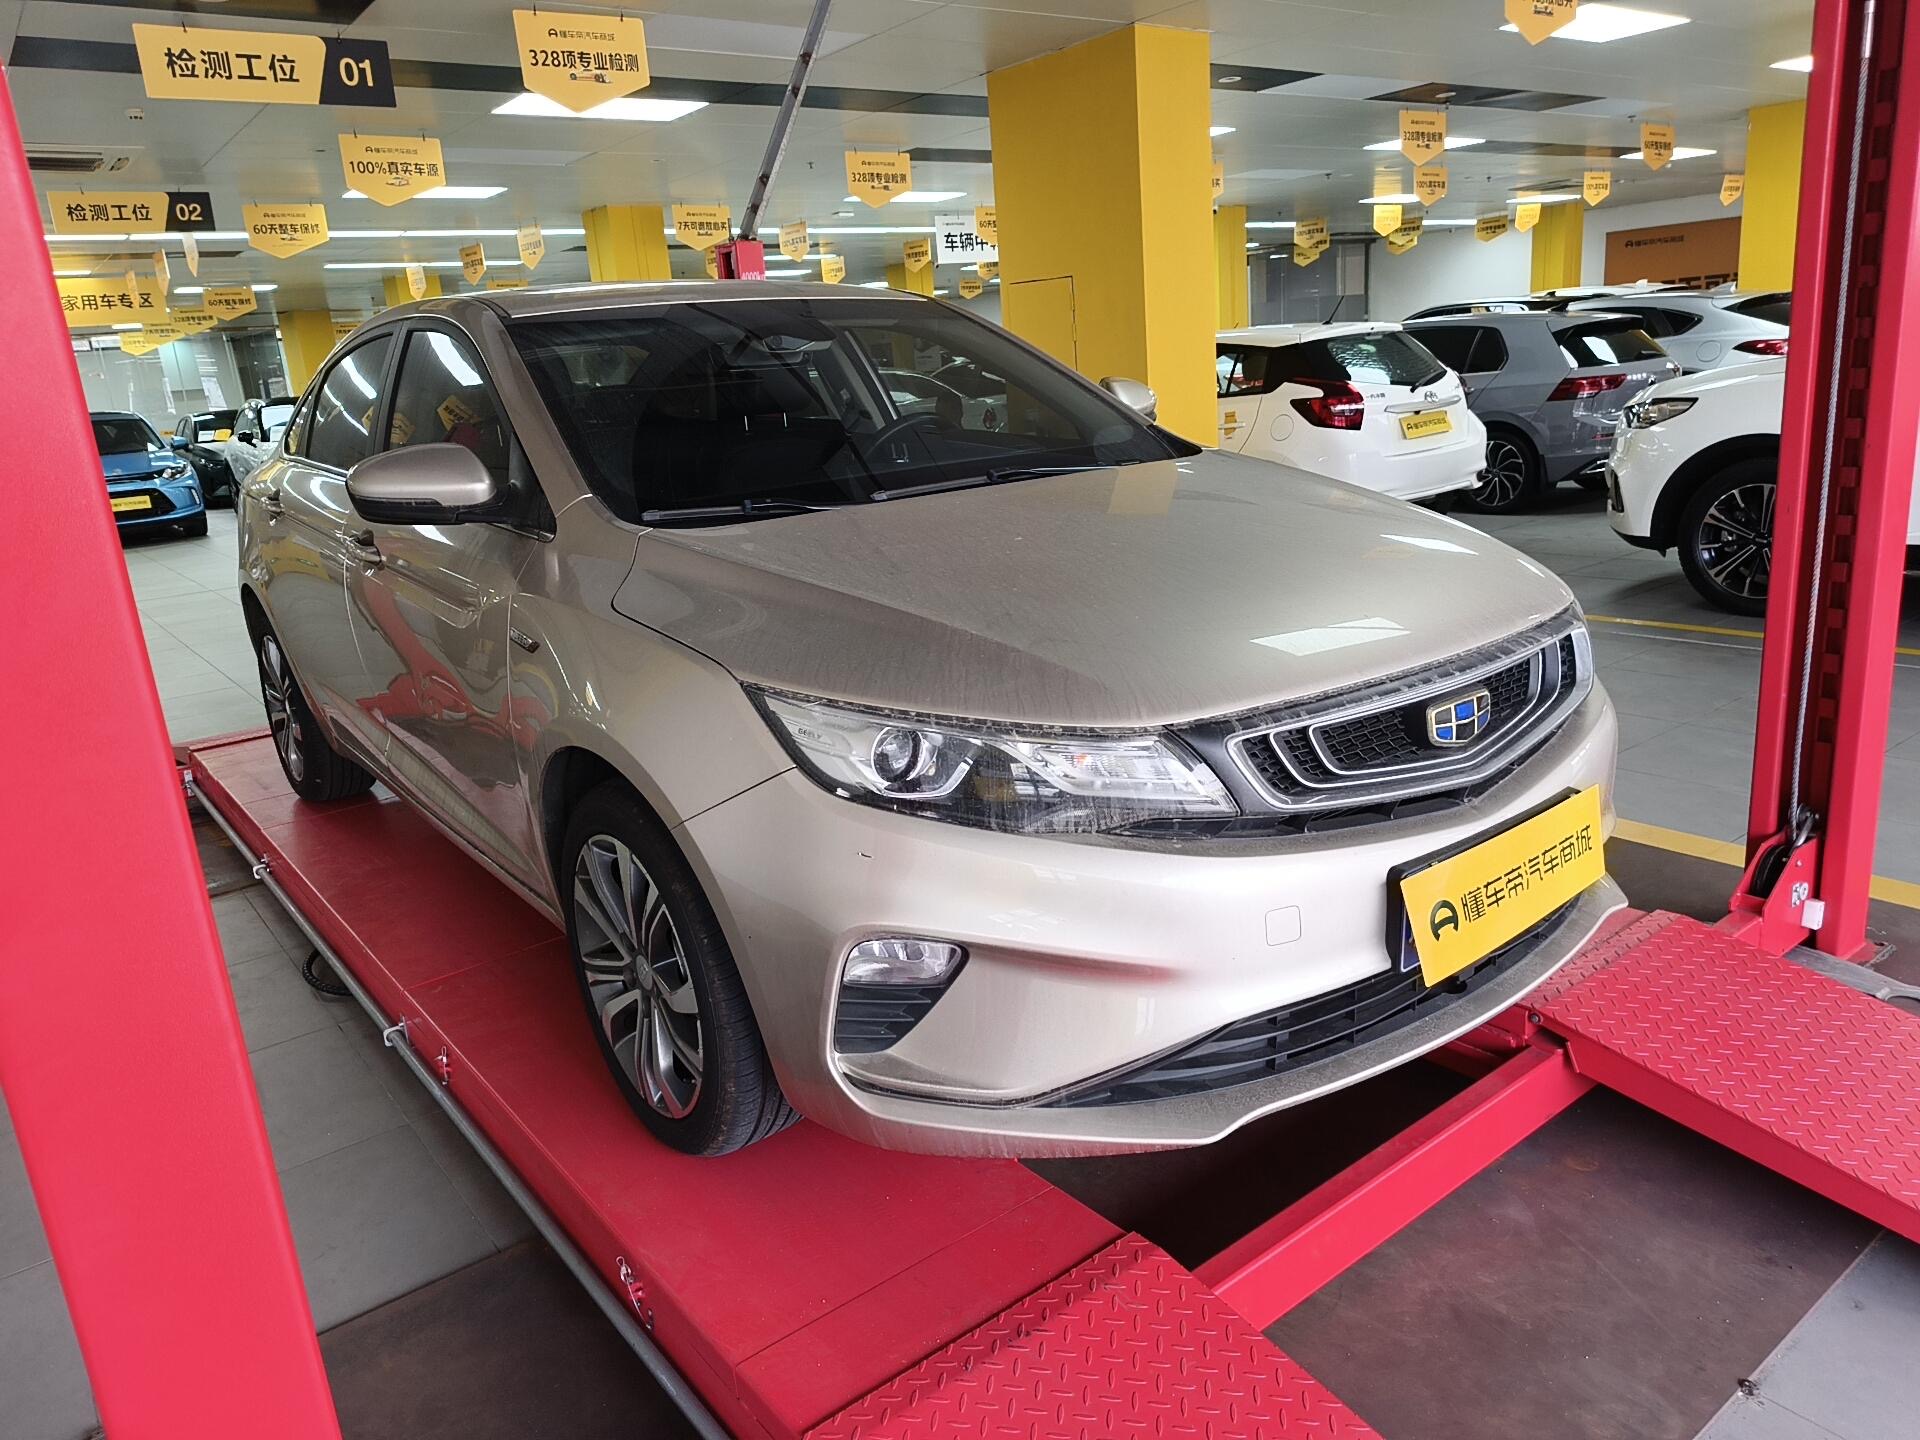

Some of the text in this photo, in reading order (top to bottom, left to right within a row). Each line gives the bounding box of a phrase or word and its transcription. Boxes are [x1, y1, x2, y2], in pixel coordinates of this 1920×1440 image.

[164, 47, 374, 87] 检测工位 01
[529, 49, 639, 72] 328项专业检测
[349, 161, 439, 176] 100%真实车源
[851, 172, 907, 184] 328项专业检测
[66, 203, 203, 222] 检测工位 02
[253, 223, 320, 234] 60天整车保修
[944, 232, 997, 252] 车辆中
[61, 293, 154, 312] 家用车专区
[1461, 824, 1592, 923] 懂车帝汽车商城
